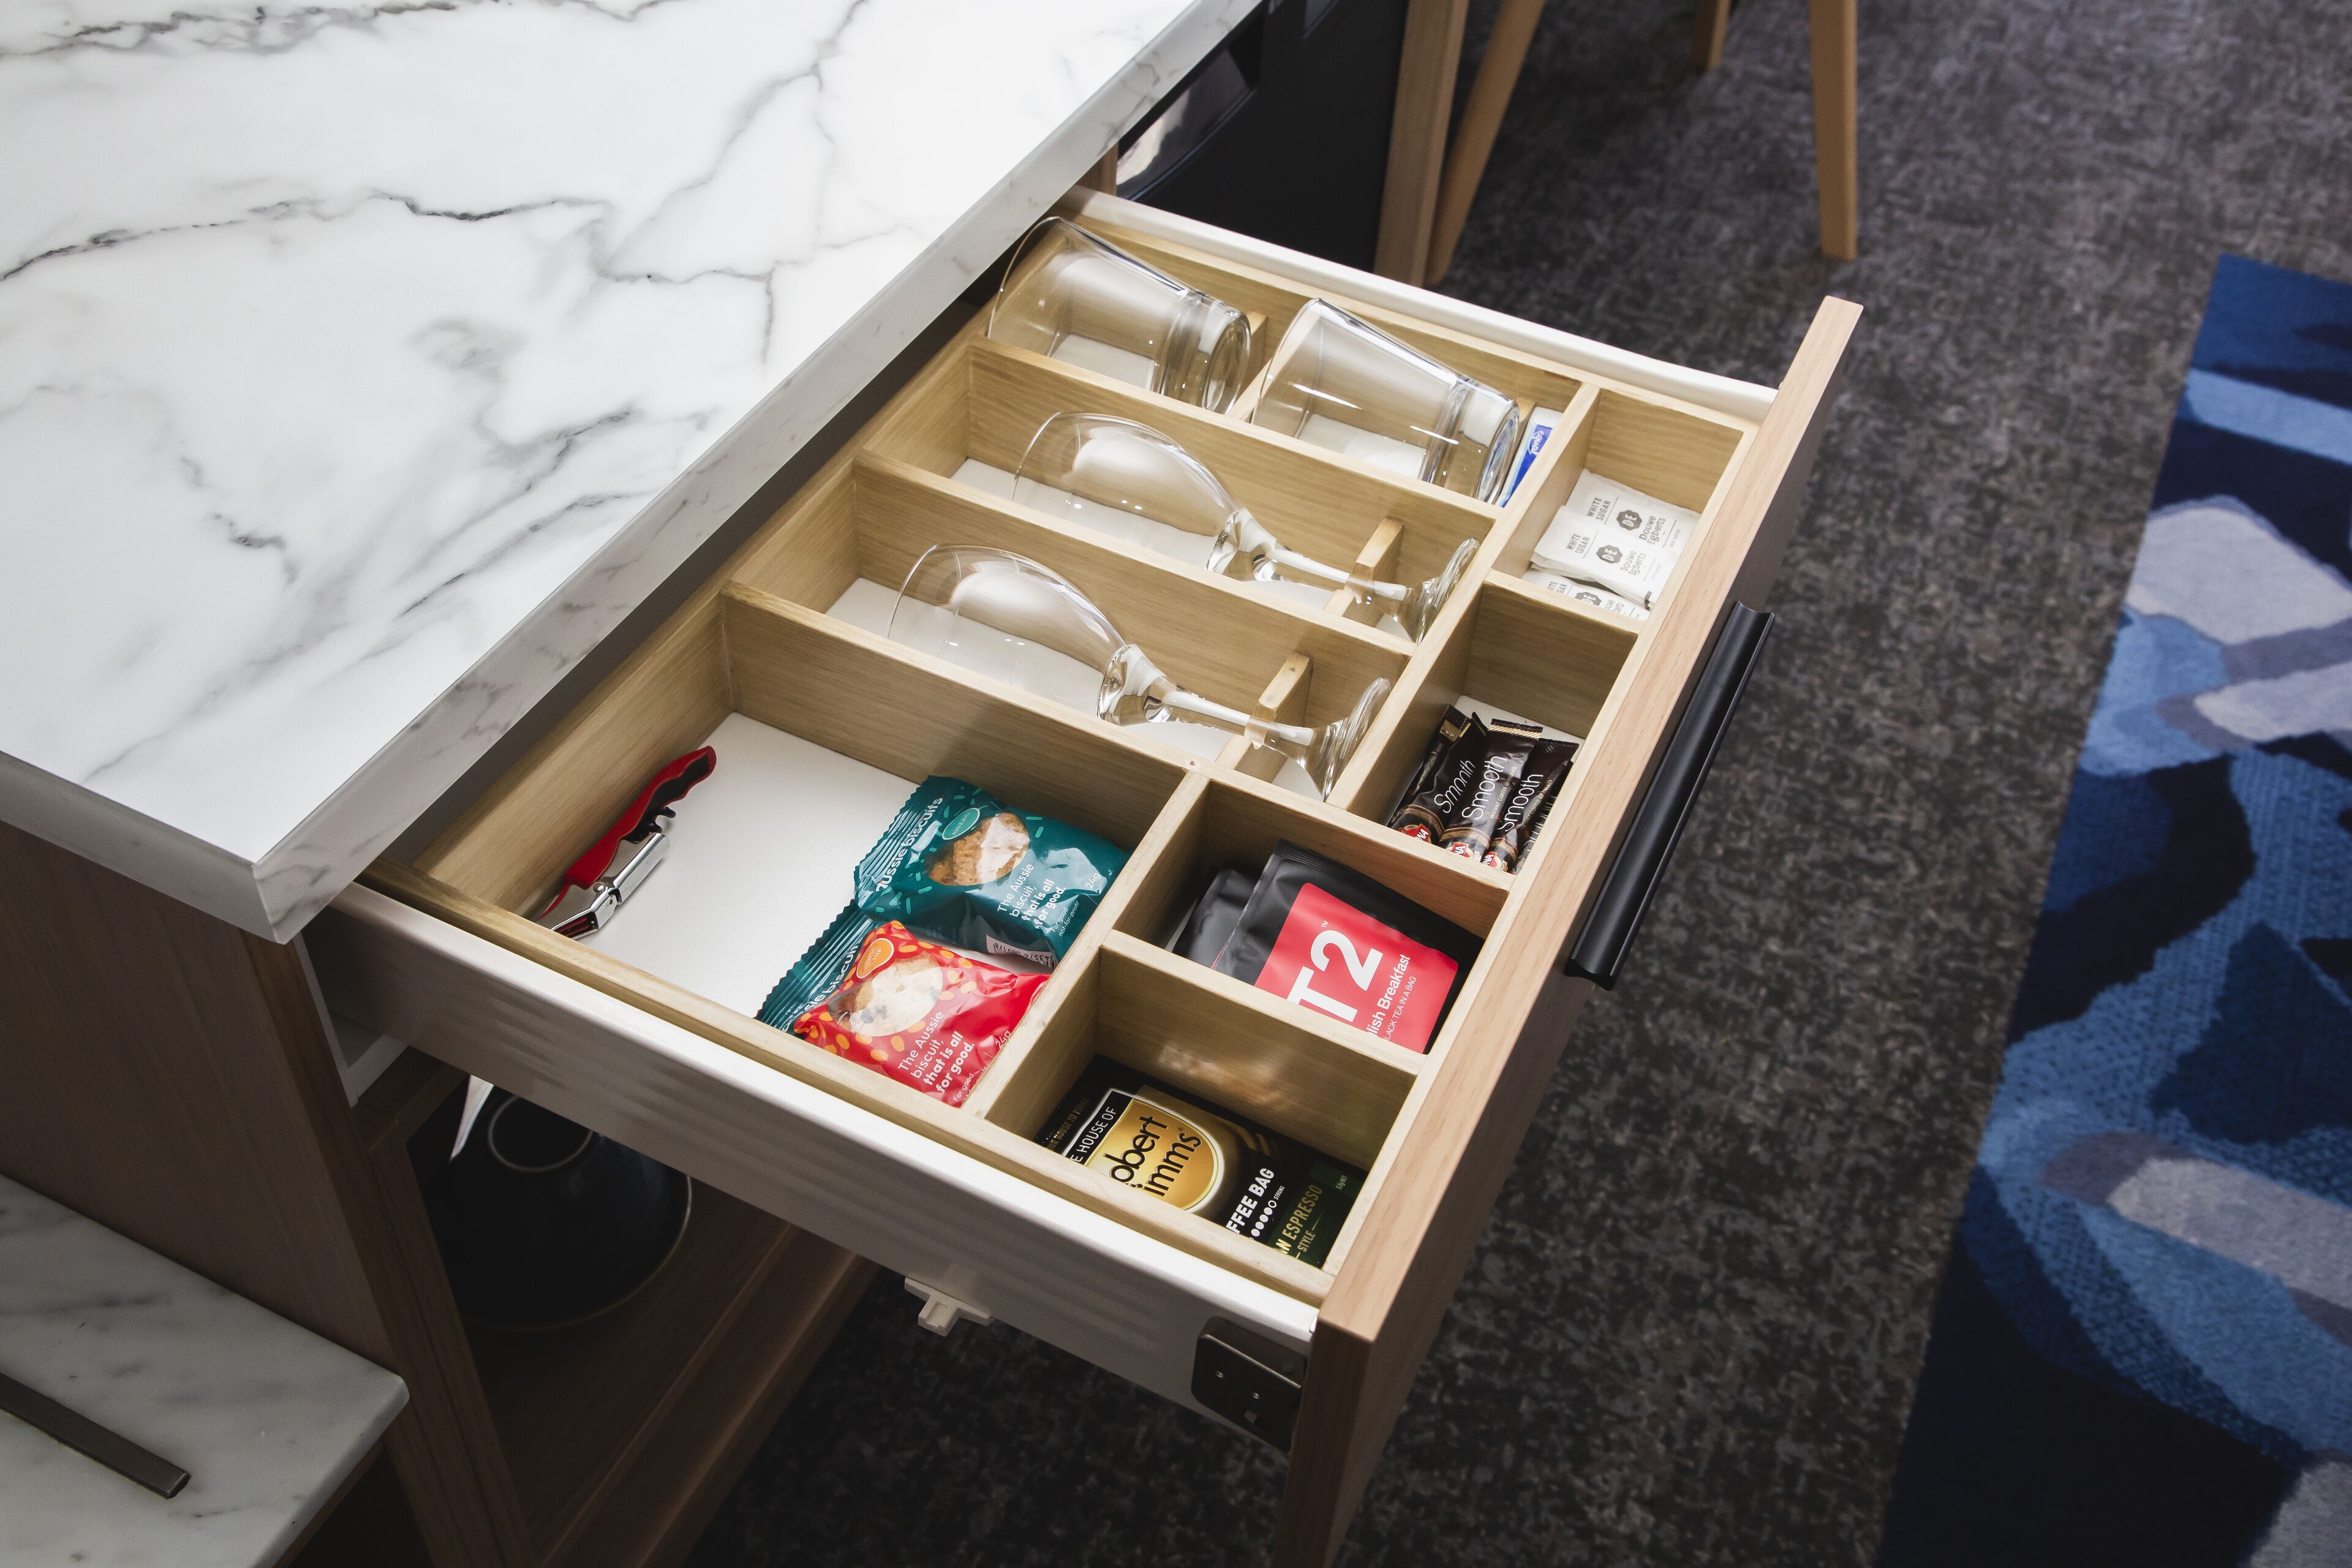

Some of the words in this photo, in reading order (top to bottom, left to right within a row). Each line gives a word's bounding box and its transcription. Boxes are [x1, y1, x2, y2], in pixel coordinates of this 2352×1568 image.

[1586, 497, 1602, 516] WHITE
[1596, 500, 1611, 521] SUGAR
[1623, 513, 1637, 527] DE
[1566, 533, 1581, 550] WHITE
[1639, 516, 1656, 540] Douwe
[1647, 518, 1666, 545] Egberts
[1575, 537, 1591, 554] SUGAR
[1602, 548, 1618, 561] DE
[1620, 550, 1637, 571] Douwe
[1628, 552, 1646, 575] Egberts
[1548, 581, 1558, 591] ITE
[1556, 583, 1569, 594] GAR
[1461, 756, 1507, 820] Smooth
[1490, 801, 1501, 820] INSTANT
[1498, 786, 1507, 801] COFFEE
[1497, 774, 1544, 832] Smooth
[901, 797, 943, 847] biscuits
[1531, 799, 1541, 814] COFFEE
[997, 893, 1014, 913] The
[1009, 864, 1035, 892] Aussie
[1085, 872, 1102, 889] 24g
[1009, 885, 1037, 918] biscuit,
[1021, 898, 1039, 921] that
[1034, 892, 1046, 901] is
[1042, 878, 1055, 892] all
[1033, 908, 1049, 926] for
[1046, 887, 1066, 910] good.
[1050, 921, 1060, 932] For
[1058, 907, 1068, 924] good
[1058, 900, 1080, 937] not-for-profit
[825, 943, 859, 994] biscuit
[1286, 930, 1384, 1022] T2
[1366, 1011, 1386, 1034] lish
[1377, 954, 1411, 1010] Breakfast
[1384, 1019, 1398, 1040] LACK
[1392, 1005, 1404, 1019] TEA
[1399, 997, 1408, 1005] IN
[1406, 976, 1417, 992] BAG
[898, 1050, 919, 1071] The
[914, 1012, 944, 1049] Aussie
[910, 1038, 944, 1079] biscuit,
[923, 1058, 945, 1085] that
[940, 1047, 954, 1060] is
[950, 1030, 963, 1047] all
[936, 1072, 953, 1093] for
[950, 1042, 975, 1075] good.
[953, 1090, 963, 1102] For
[962, 1073, 974, 1091] good
[1054, 1121, 1072, 1140] HOUSE
[1067, 1114, 1077, 1122] TO
[1076, 1120, 1109, 1153] HOUSE
[1101, 1106, 1117, 1120] OF
[1103, 1116, 1169, 1183] obert
[1134, 1133, 1202, 1196] imms
[1226, 1195, 1258, 1234] FFEE
[1248, 1168, 1275, 1197] BAG
[1273, 1185, 1285, 1200] STRONG
[1282, 1185, 1323, 1241] ESPRESSO
[1297, 1230, 1316, 1252] STYLE
